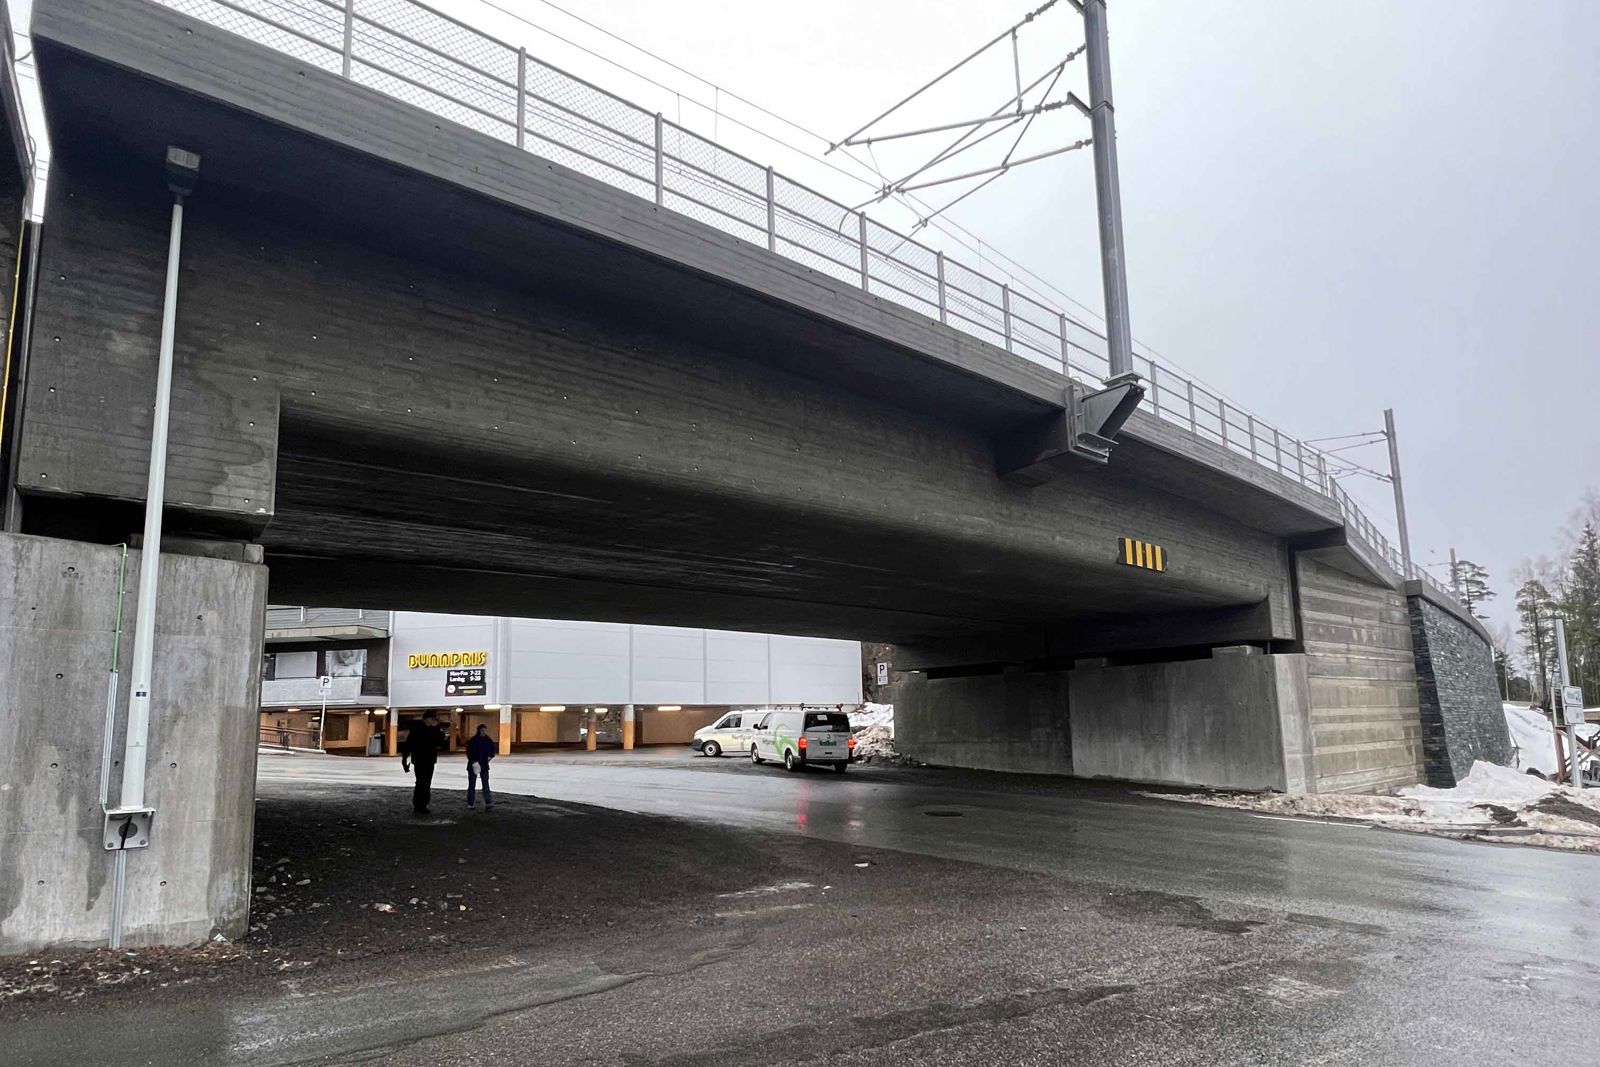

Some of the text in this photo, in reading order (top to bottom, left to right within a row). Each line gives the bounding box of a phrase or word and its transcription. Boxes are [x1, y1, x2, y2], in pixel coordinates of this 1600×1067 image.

[408, 652, 486, 668] BUNNPRIS
[880, 664, 885, 674] P
[322, 678, 330, 686] P
